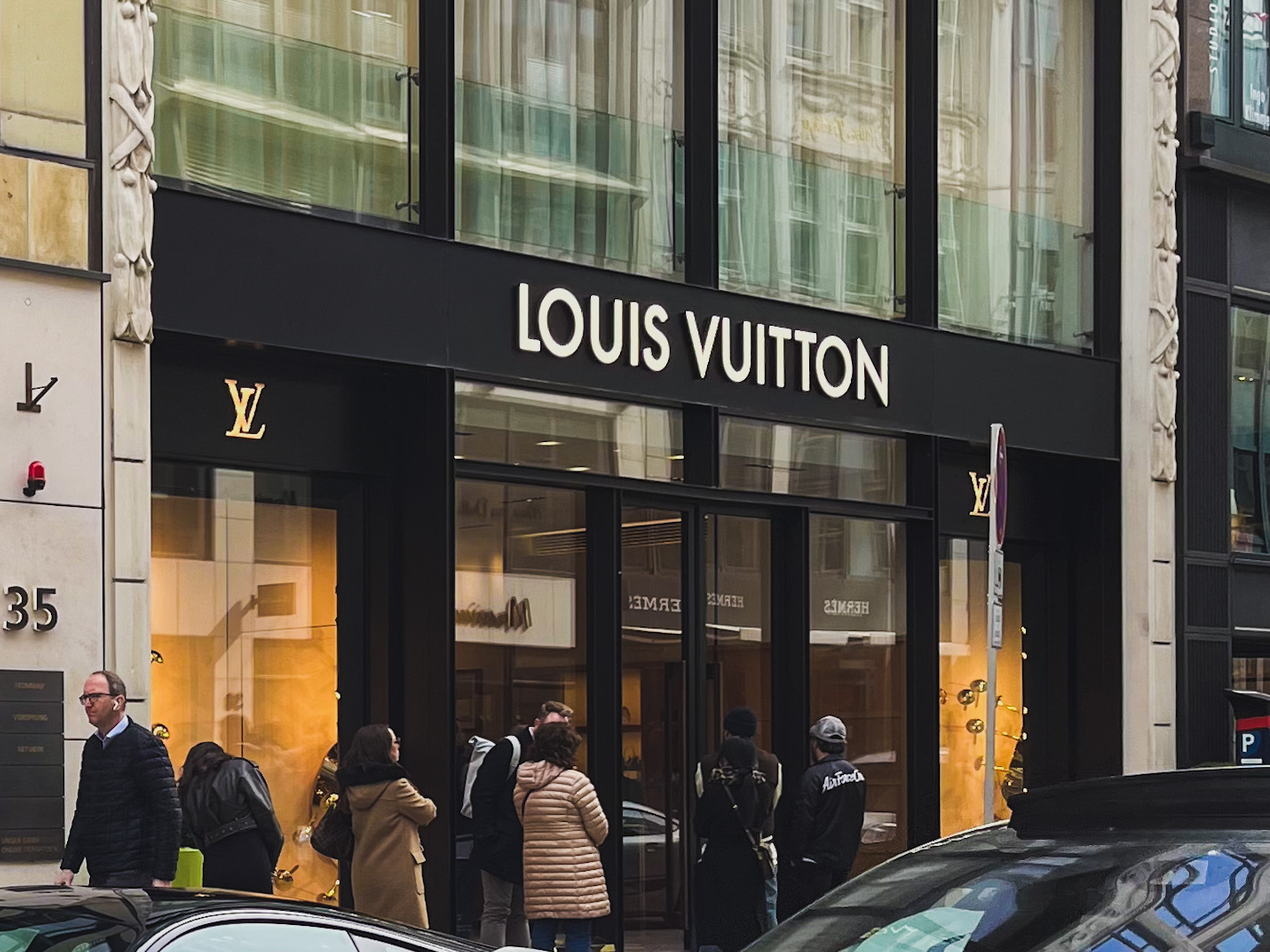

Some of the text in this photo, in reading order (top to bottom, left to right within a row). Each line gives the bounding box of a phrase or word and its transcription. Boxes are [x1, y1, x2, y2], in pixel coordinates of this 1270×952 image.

[518, 282, 889, 407] LOUIS VUITTON
[2, 585, 58, 633] 35
[1242, 733, 1255, 753] P
